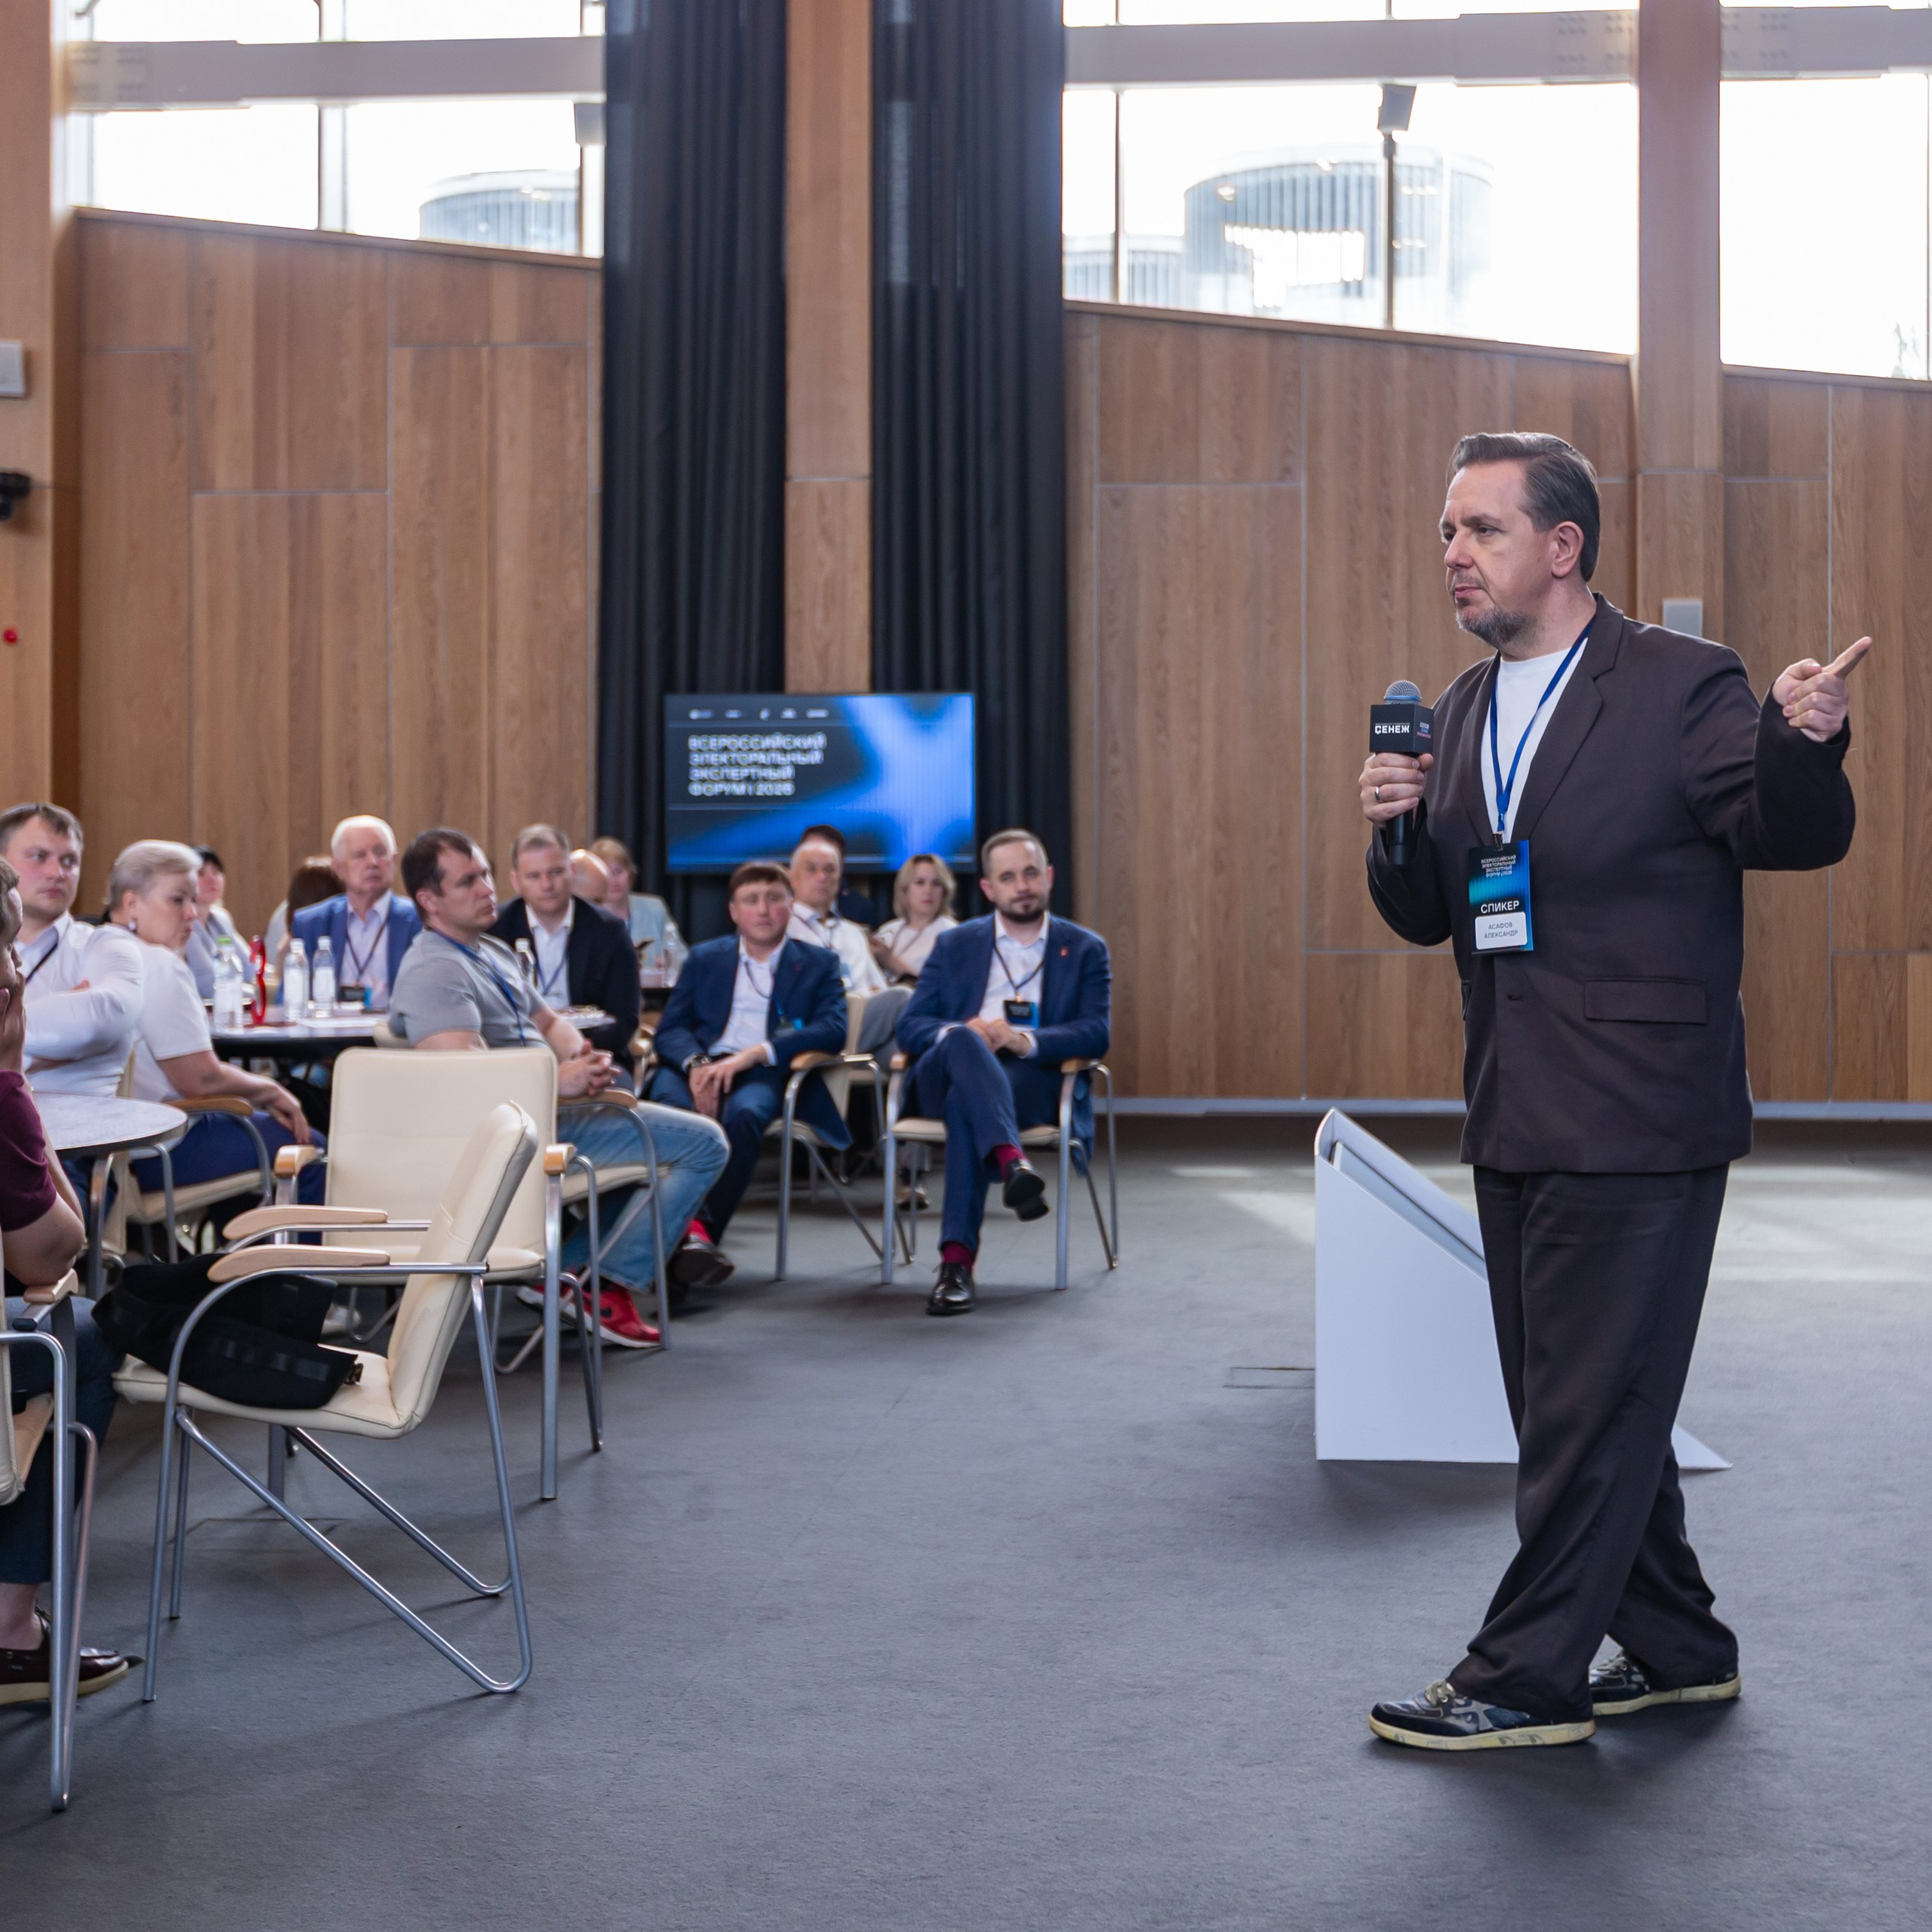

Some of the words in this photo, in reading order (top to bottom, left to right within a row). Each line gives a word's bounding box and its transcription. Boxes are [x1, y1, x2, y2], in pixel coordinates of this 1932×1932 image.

[1374, 725, 1409, 734] СЕНЕЖ
[688, 733, 826, 751] ВСЕРОССИЙСКИЙ
[688, 750, 824, 765] ЭЛЕКТОРАЛЬНЫЙ
[688, 764, 795, 781] ЭКСПЕРТНЫЙ
[688, 780, 746, 796] ФОРУМ
[1481, 854, 1516, 864] ВСЕРОССИЙСКИЙ
[1481, 900, 1519, 913] СПИКЕР
[1484, 930, 1518, 938] АЛЕКСАНДР
